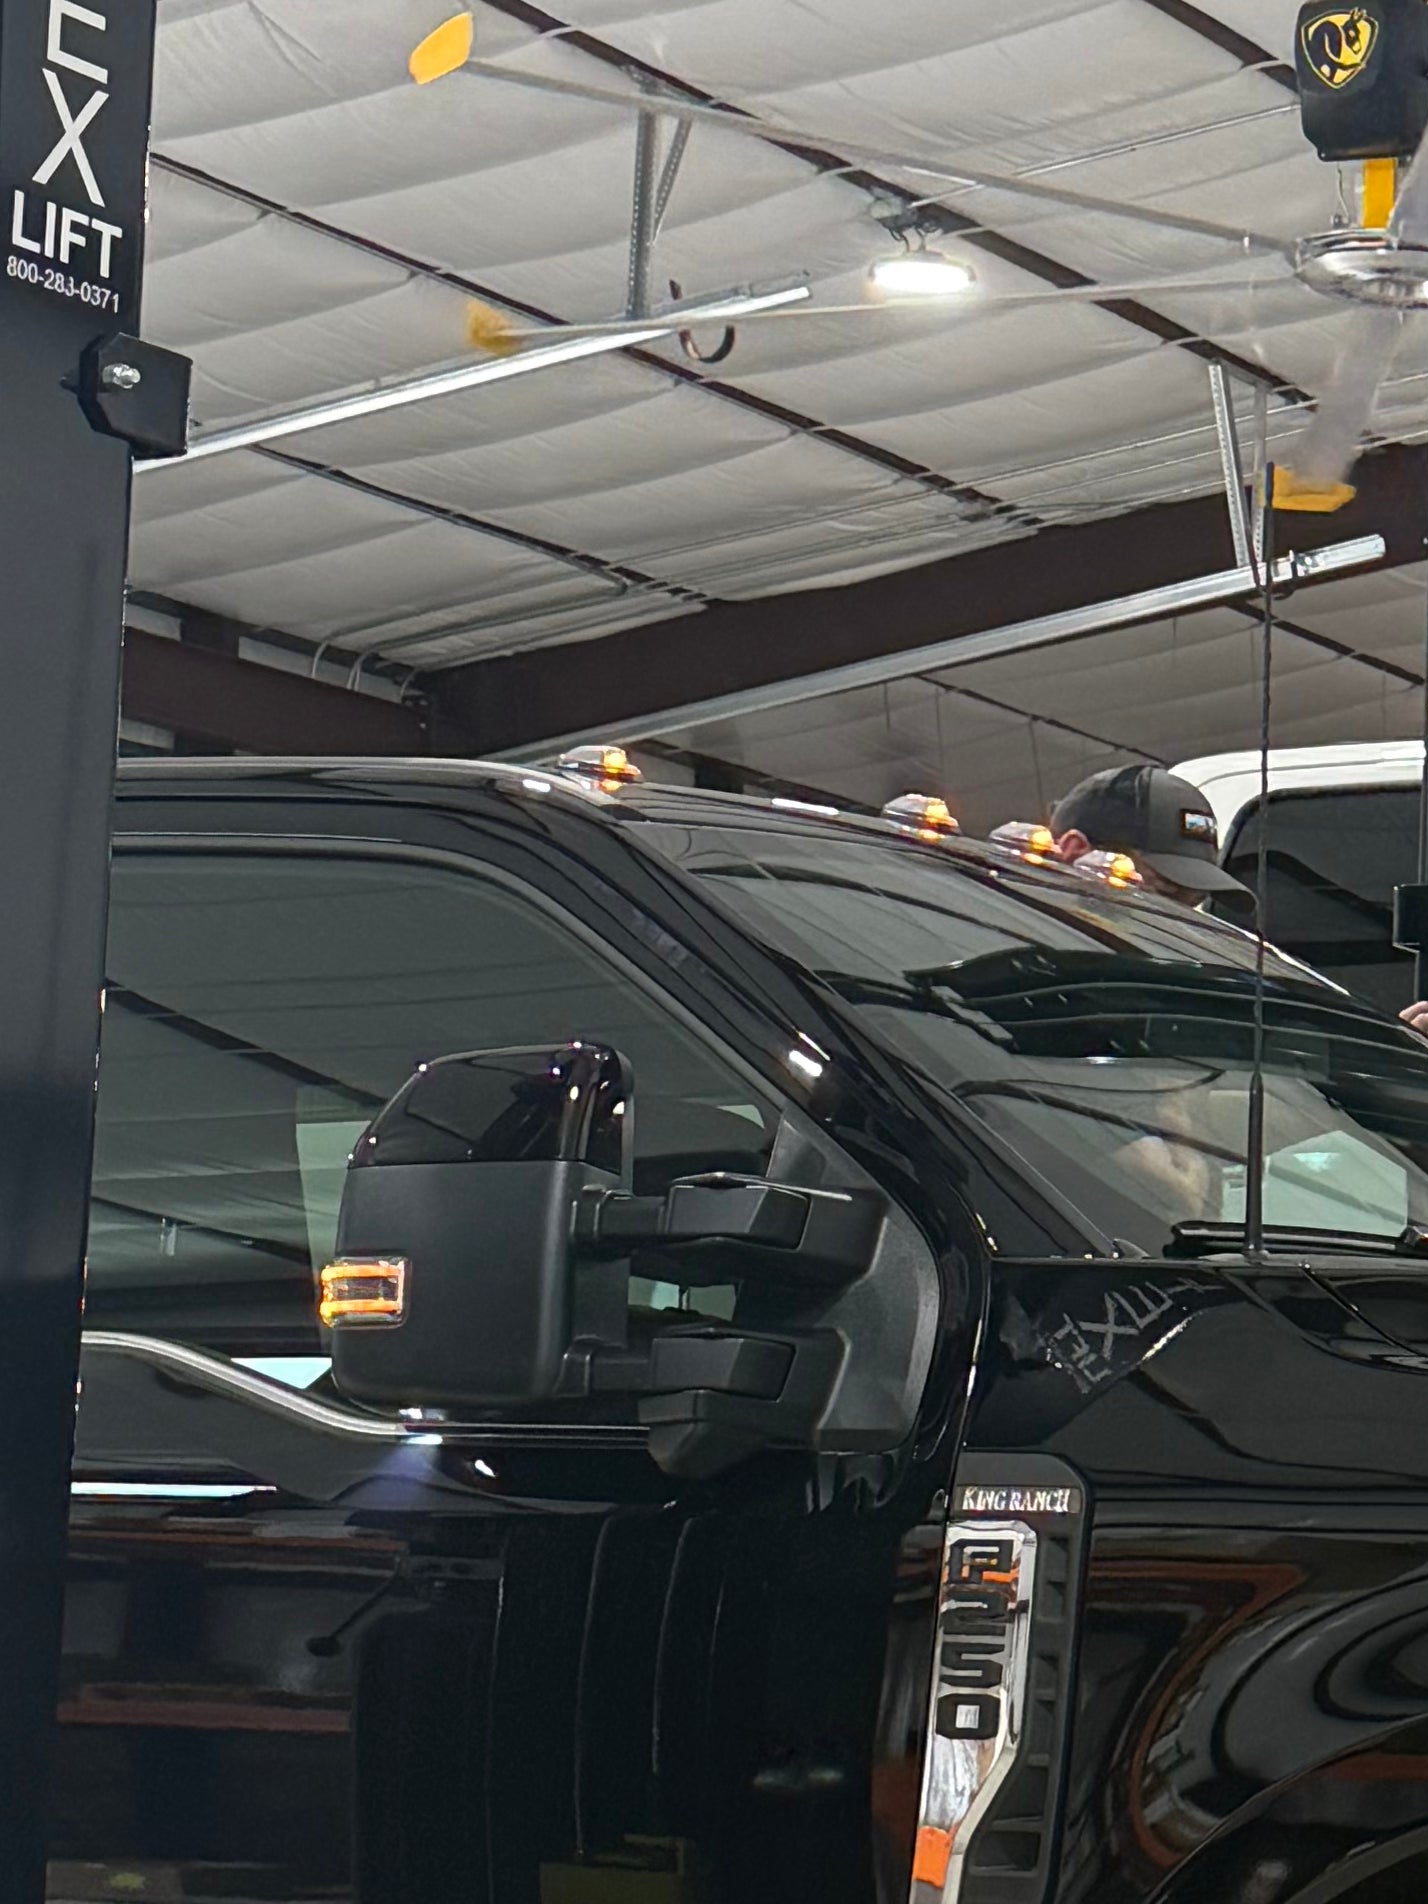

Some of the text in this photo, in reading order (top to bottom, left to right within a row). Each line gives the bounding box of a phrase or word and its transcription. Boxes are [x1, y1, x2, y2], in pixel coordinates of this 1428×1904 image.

[12, 189, 123, 278] LIFT
[6, 255, 119, 313] 800-283-0371
[962, 1486, 1070, 1512] KING RANCH
